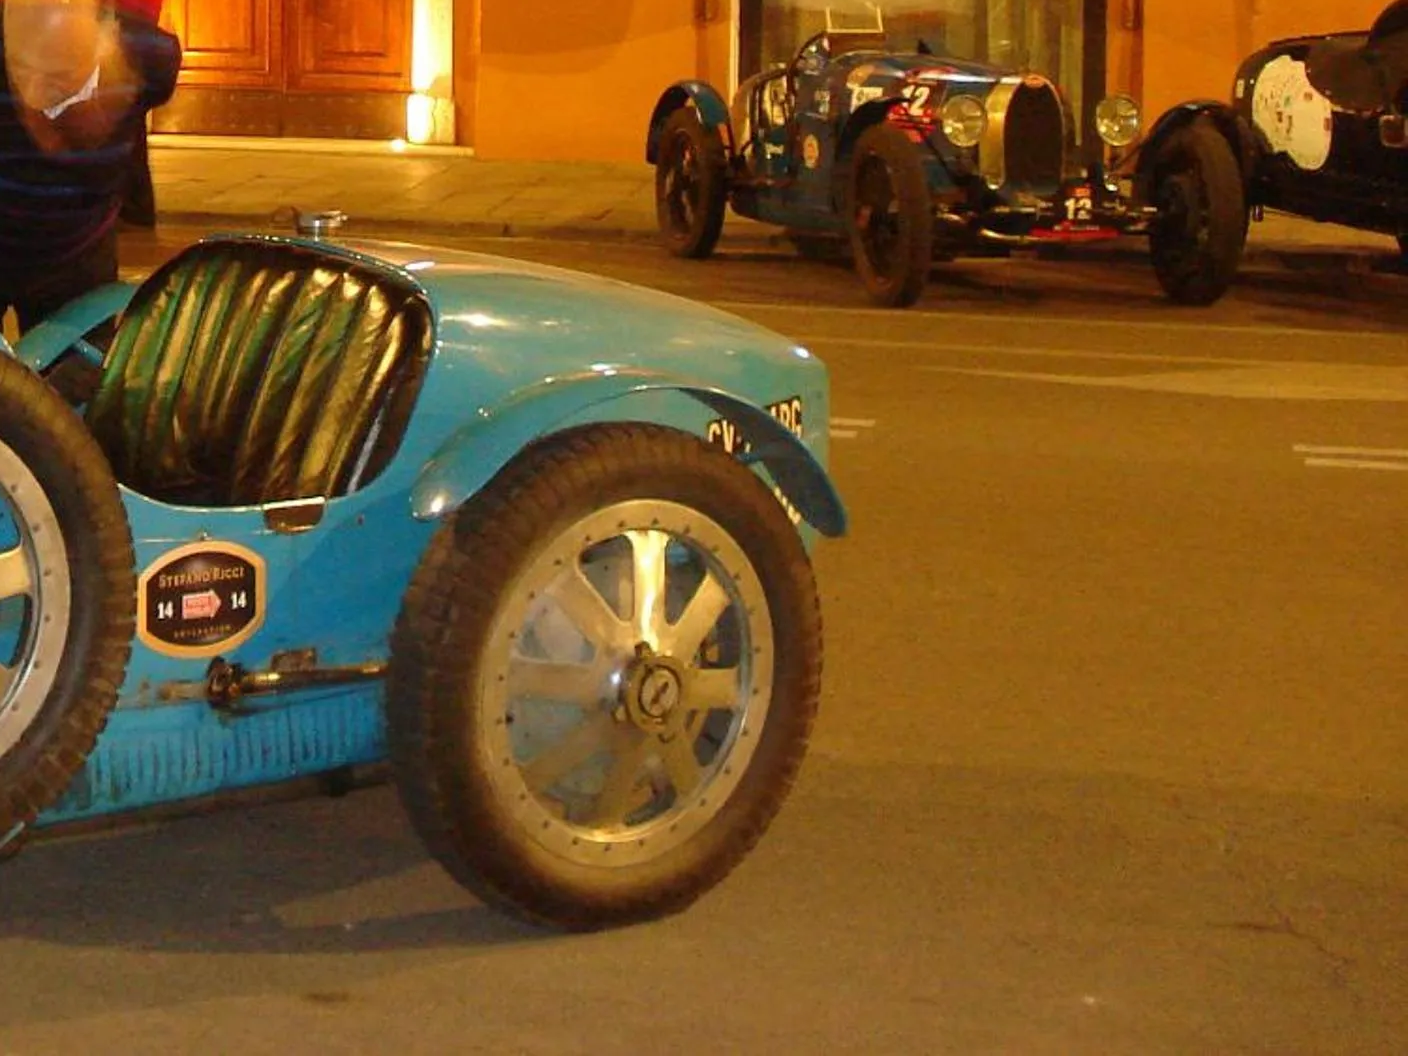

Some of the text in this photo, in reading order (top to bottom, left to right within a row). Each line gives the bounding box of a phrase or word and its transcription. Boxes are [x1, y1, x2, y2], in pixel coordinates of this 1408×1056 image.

[902, 85, 930, 116] 12
[159, 566, 245, 587] STEFANO RICCI
[157, 601, 174, 619] 14
[231, 590, 247, 610] 14
